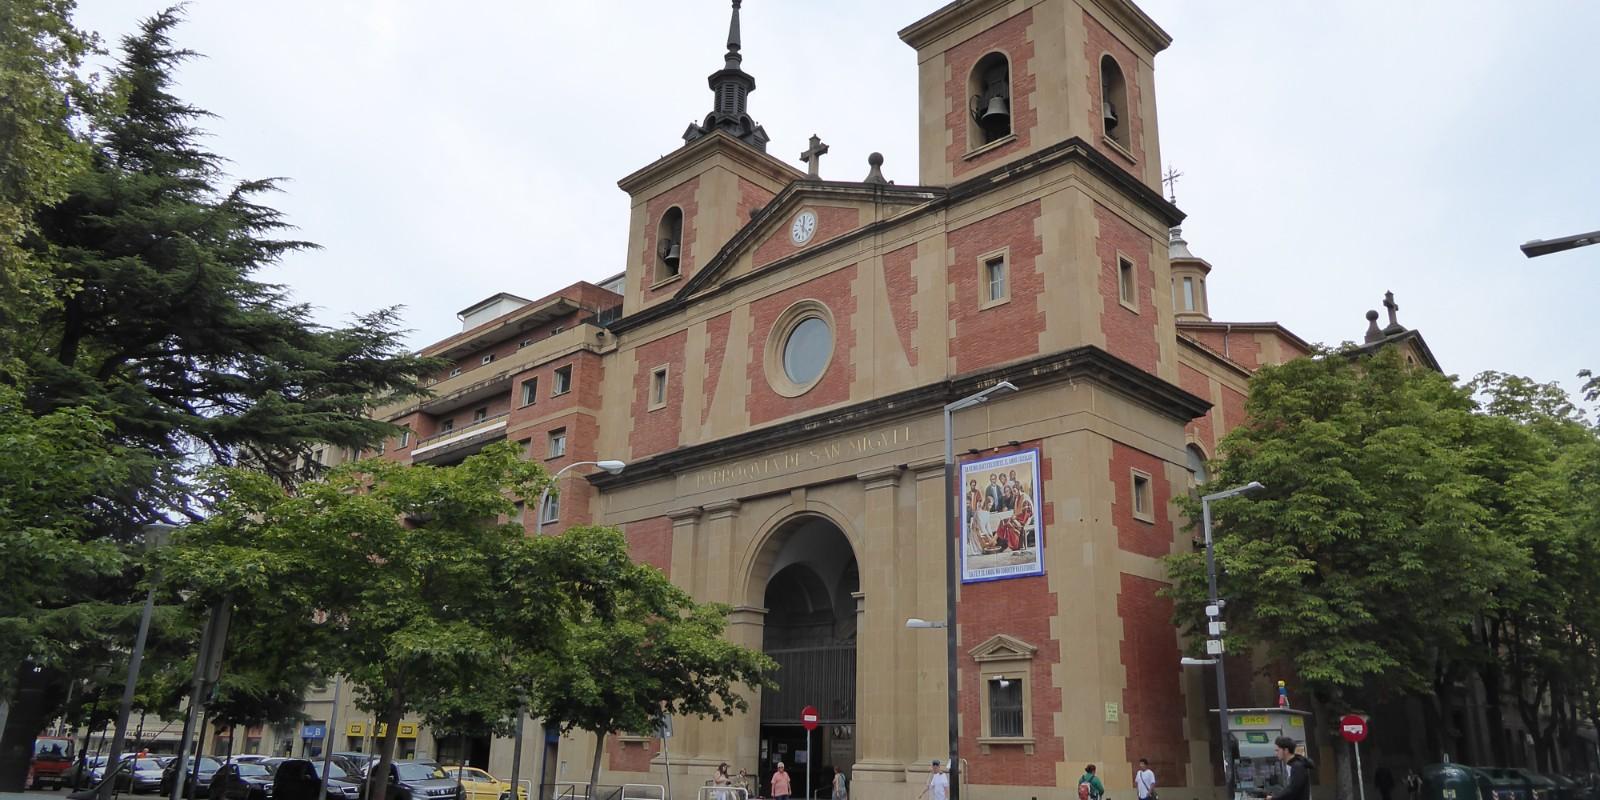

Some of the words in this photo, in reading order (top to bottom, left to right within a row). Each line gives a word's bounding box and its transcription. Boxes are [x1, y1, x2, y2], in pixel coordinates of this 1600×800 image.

[696, 459, 779, 487] PARROQVIA
[785, 454, 800, 469] DE
[810, 441, 840, 464] SAN
[848, 426, 912, 456] MIGVEL
[1244, 715, 1265, 724] ONCE
